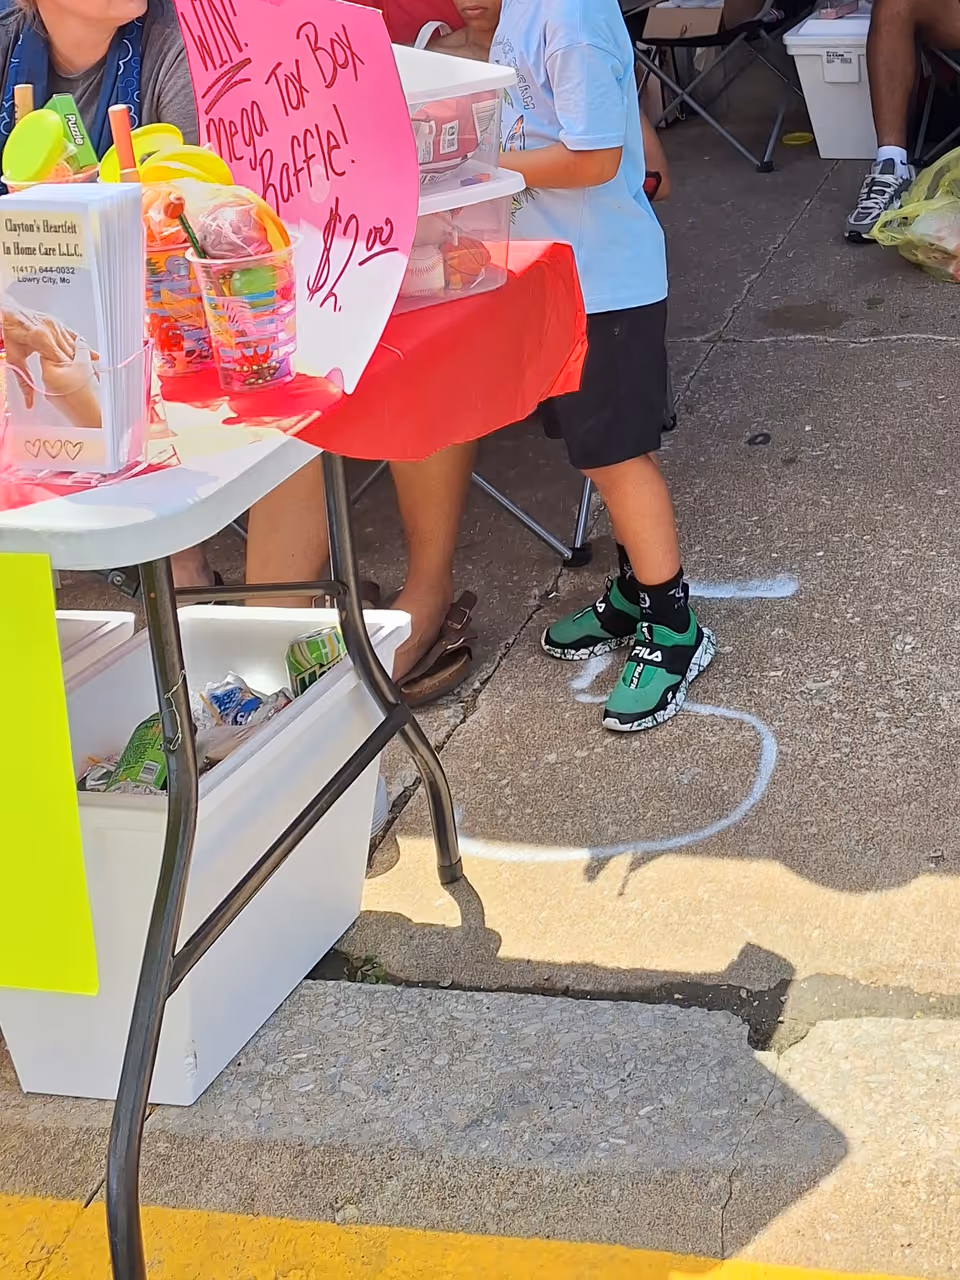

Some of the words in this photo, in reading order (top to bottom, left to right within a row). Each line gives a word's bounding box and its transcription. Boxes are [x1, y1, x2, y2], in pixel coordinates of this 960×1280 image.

[64, 113, 85, 146] Puzzle
[4, 218, 40, 237] Clayton's
[42, 219, 78, 235] Heartfelt
[2, 241, 12, 255] In
[13, 241, 37, 256] Home
[38, 242, 57, 256] Care
[57, 243, 83, 257] L.L.C.
[12, 265, 37, 275] 1(417)
[38, 266, 76, 275] 644-0032
[17, 276, 40, 284] Lowry
[41, 276, 58, 285] City,
[60, 276, 71, 284] Mo
[631, 646, 663, 662] FILA
